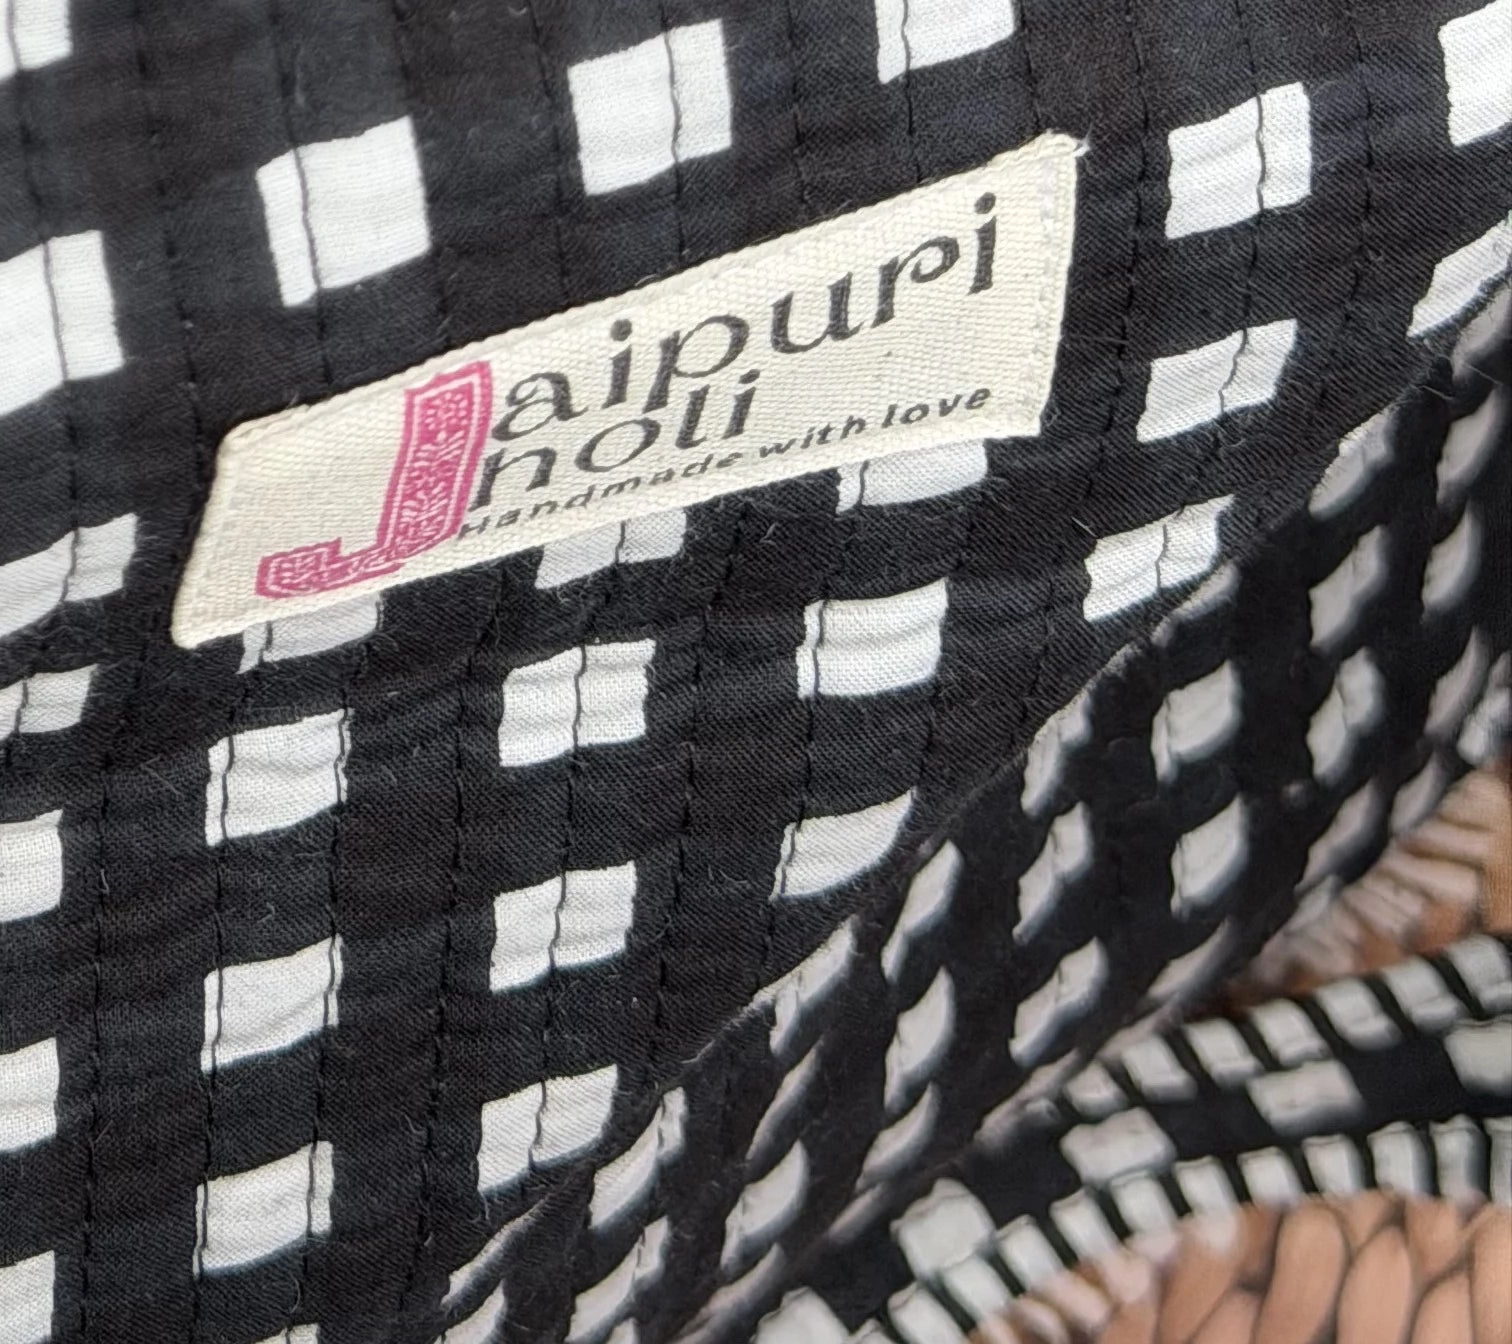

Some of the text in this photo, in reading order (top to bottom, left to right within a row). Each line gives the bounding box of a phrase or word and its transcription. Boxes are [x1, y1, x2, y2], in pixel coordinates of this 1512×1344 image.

[458, 386, 992, 540] Handmade with love
